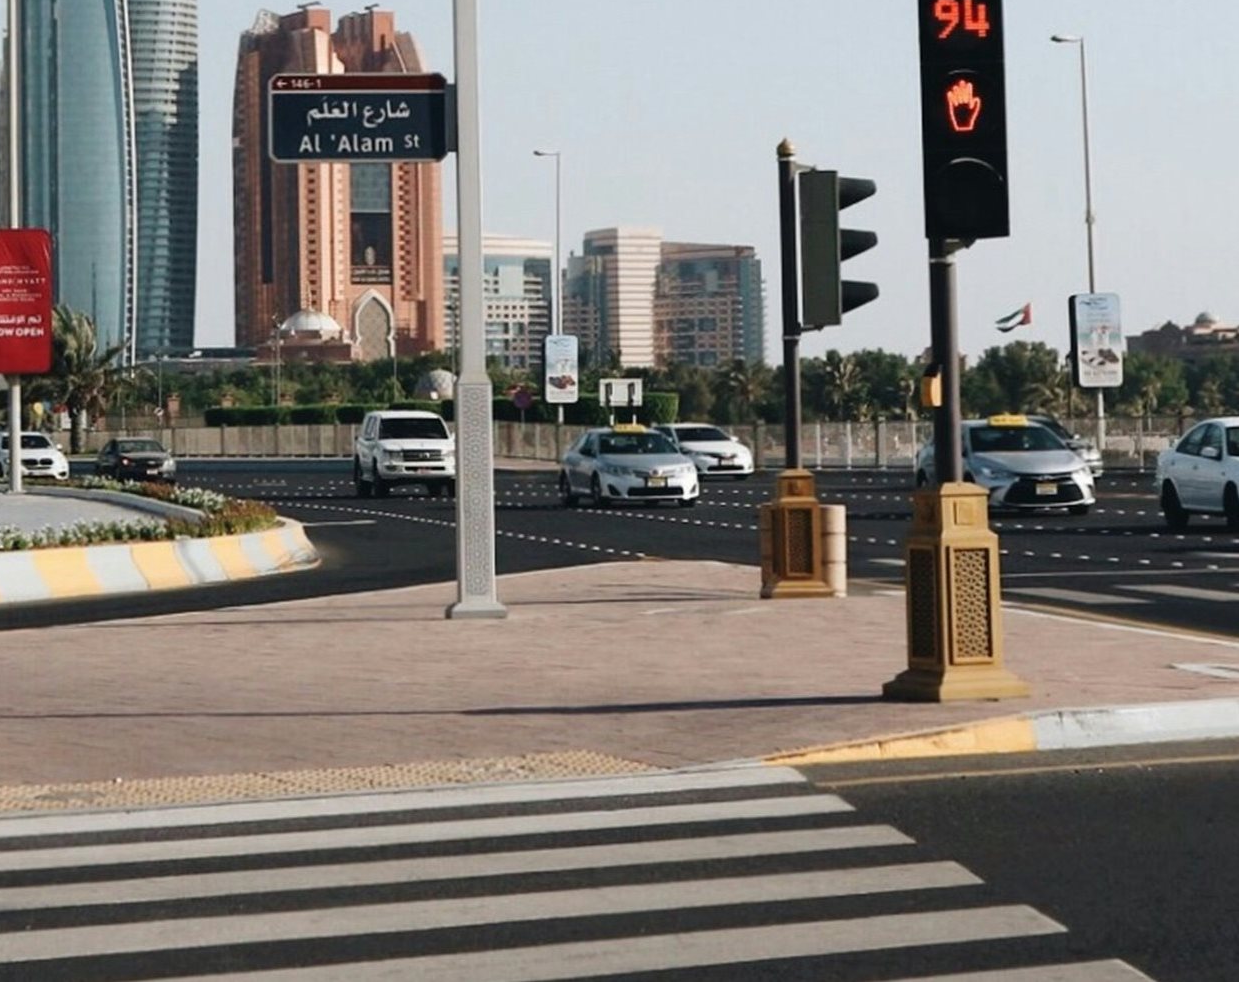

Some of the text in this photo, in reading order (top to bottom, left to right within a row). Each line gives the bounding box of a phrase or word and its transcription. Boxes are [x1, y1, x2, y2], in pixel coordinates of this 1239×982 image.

[362, 99, 410, 128] شارع
[299, 133, 321, 153] Al
[404, 133, 420, 149] St
[15, 327, 44, 336] OPEN
